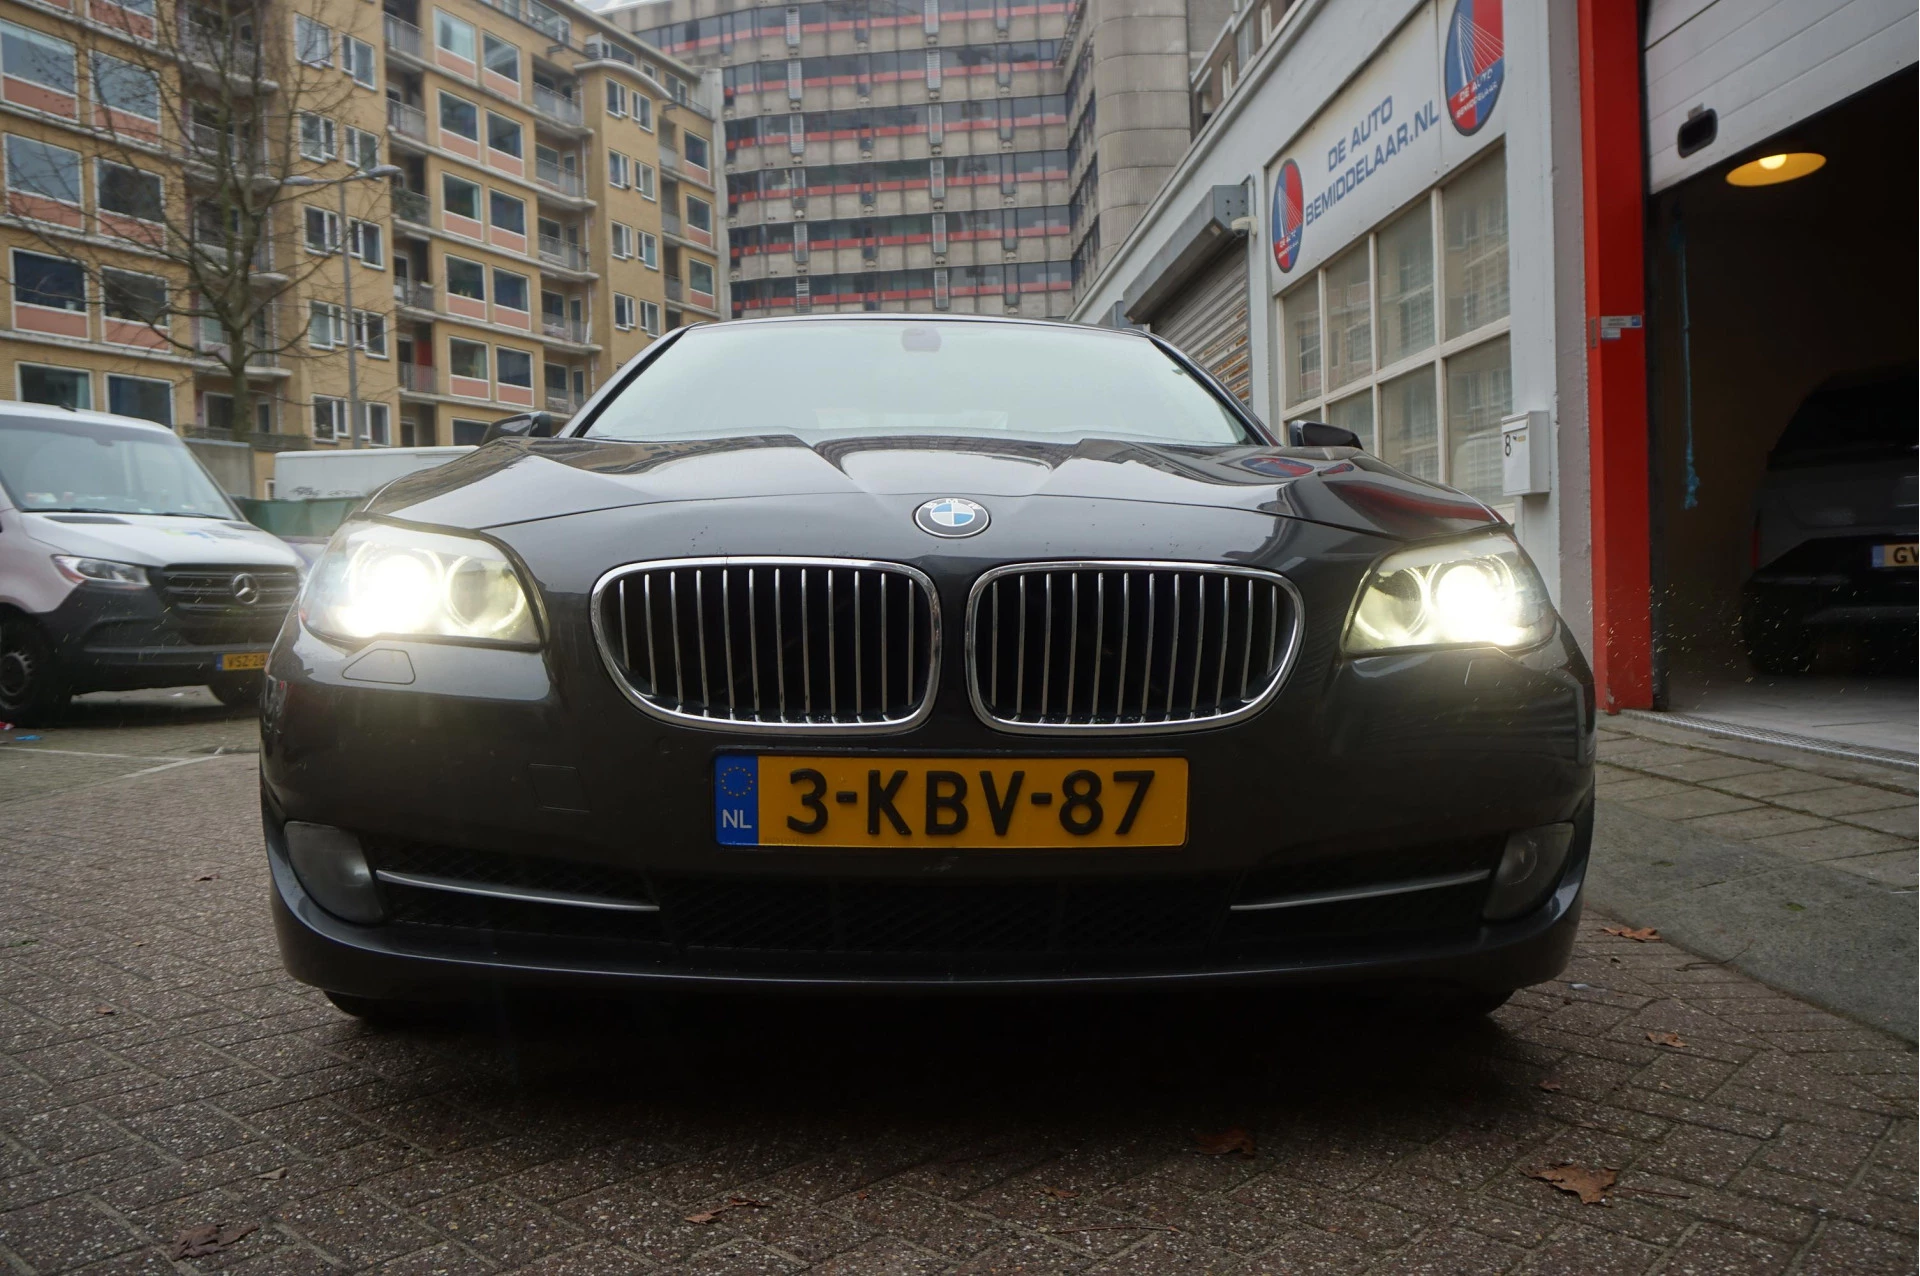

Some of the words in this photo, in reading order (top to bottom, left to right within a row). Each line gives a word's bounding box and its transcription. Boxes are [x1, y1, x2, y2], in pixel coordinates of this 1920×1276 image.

[1304, 99, 1440, 227] BEMIDDELAAR.NL
[1328, 136, 1347, 173] DE
[1350, 95, 1393, 153] AUTO
[1504, 434, 1511, 457] 8
[722, 809, 752, 829] NL
[786, 767, 1156, 837] 3-KBV-87
